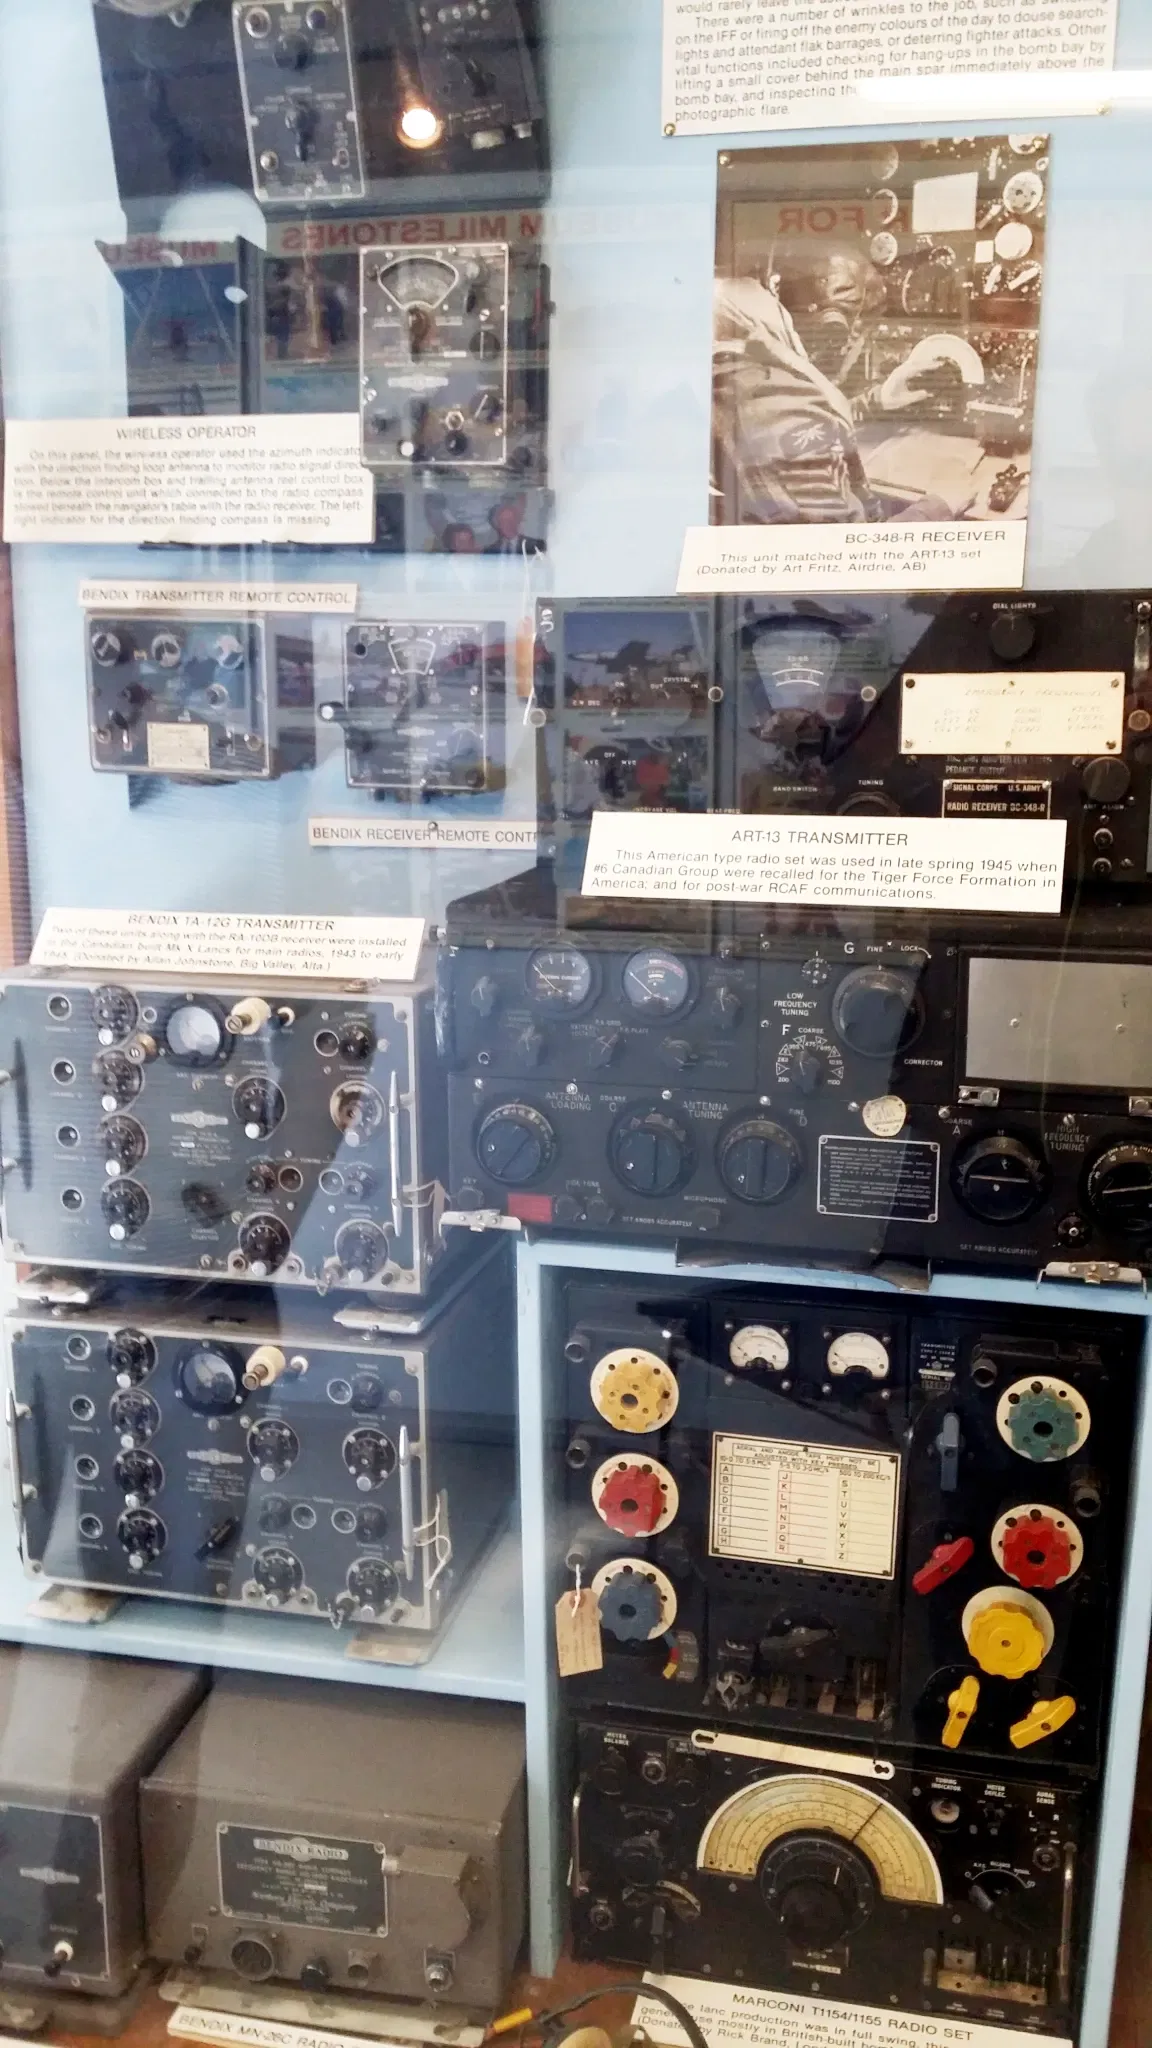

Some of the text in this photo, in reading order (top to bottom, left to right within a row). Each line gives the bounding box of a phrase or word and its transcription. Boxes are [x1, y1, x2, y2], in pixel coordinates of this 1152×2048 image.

[696, 14, 729, 28] There
[735, 15, 763, 26] were
[768, 14, 776, 24] a
[780, 8, 828, 23] number
[833, 7, 845, 20] of
[851, 4, 904, 19] wrinkles
[910, 2, 922, 15] to
[928, 1, 948, 14] the
[984, 0, 1014, 11] such
[676, 8, 1108, 45] on the IFF or firing off the enemy colours of the day to douse search-
[676, 46, 709, 63] lights
[713, 45, 735, 58] and
[739, 41, 796, 57] attendant
[800, 40, 822, 53] flak
[887, 38, 900, 48] or
[903, 32, 962, 50] deterring
[966, 29, 1008, 46] fighter
[1068, 24, 1106, 38] Other
[116, 426, 257, 440] WIRELESS OPERATOR
[846, 530, 1006, 544] BC-348-R RECEIVER
[720, 549, 982, 563] This unit matched with the ART-13 set
[696, 564, 756, 577] (Donated
[762, 564, 776, 576] by
[783, 564, 802, 573] Art
[902, 562, 926, 574] AB)
[82, 589, 349, 604] BENDIX TRANSMITTER REMOTE CONTROL
[976, 784, 998, 792] CORPS
[1022, 784, 1042, 792] ARMY
[947, 803, 969, 811] RADIO
[971, 803, 1007, 812] RECEIVER
[312, 827, 360, 840] BENDIX
[366, 828, 431, 841] RECEIVER
[436, 829, 488, 842] REMOTE
[732, 830, 908, 846] ART-13 TRANSMITTER
[616, 850, 1056, 874] This American type radio set was used in late spring 1945 when
[593, 863, 1056, 888] #6 Canadian Group were recalled for the Tiger Force Formation in
[653, 880, 676, 891] and
[682, 881, 699, 892] for
[706, 881, 762, 897] post-war
[768, 883, 806, 895] RCAF
[813, 885, 938, 900] communications.
[128, 914, 334, 931] BENDIX TA-12G TRANSMITTER
[844, 943, 854, 953] G
[774, 1001, 817, 1009] FREQUENCY
[782, 1024, 791, 1035] F
[545, 1093, 590, 1101] ANTENNA
[551, 1101, 591, 1111] LOADING
[683, 1102, 728, 1111] ANTENNA
[688, 1110, 723, 1120] TUNING
[1057, 1125, 1079, 1133] HIGH
[1045, 1132, 1090, 1143] FREQUENCY
[1050, 1143, 1084, 1152] TUNING
[700, 2004, 726, 2016] lanc
[731, 2011, 798, 2029] production
[804, 2022, 828, 2032] was
[834, 2026, 846, 2035] in
[852, 2029, 872, 2040] full
[732, 1993, 974, 2041] MARCONI T1154/1155 RADIO SET
[178, 2014, 232, 2033] BENDIX
[236, 2025, 292, 2044] MN-26C
[637, 2016, 688, 2029] (Donate
[717, 2028, 744, 2040] Rick
[718, 2020, 760, 2033] mostly
[765, 2025, 776, 2035] in
